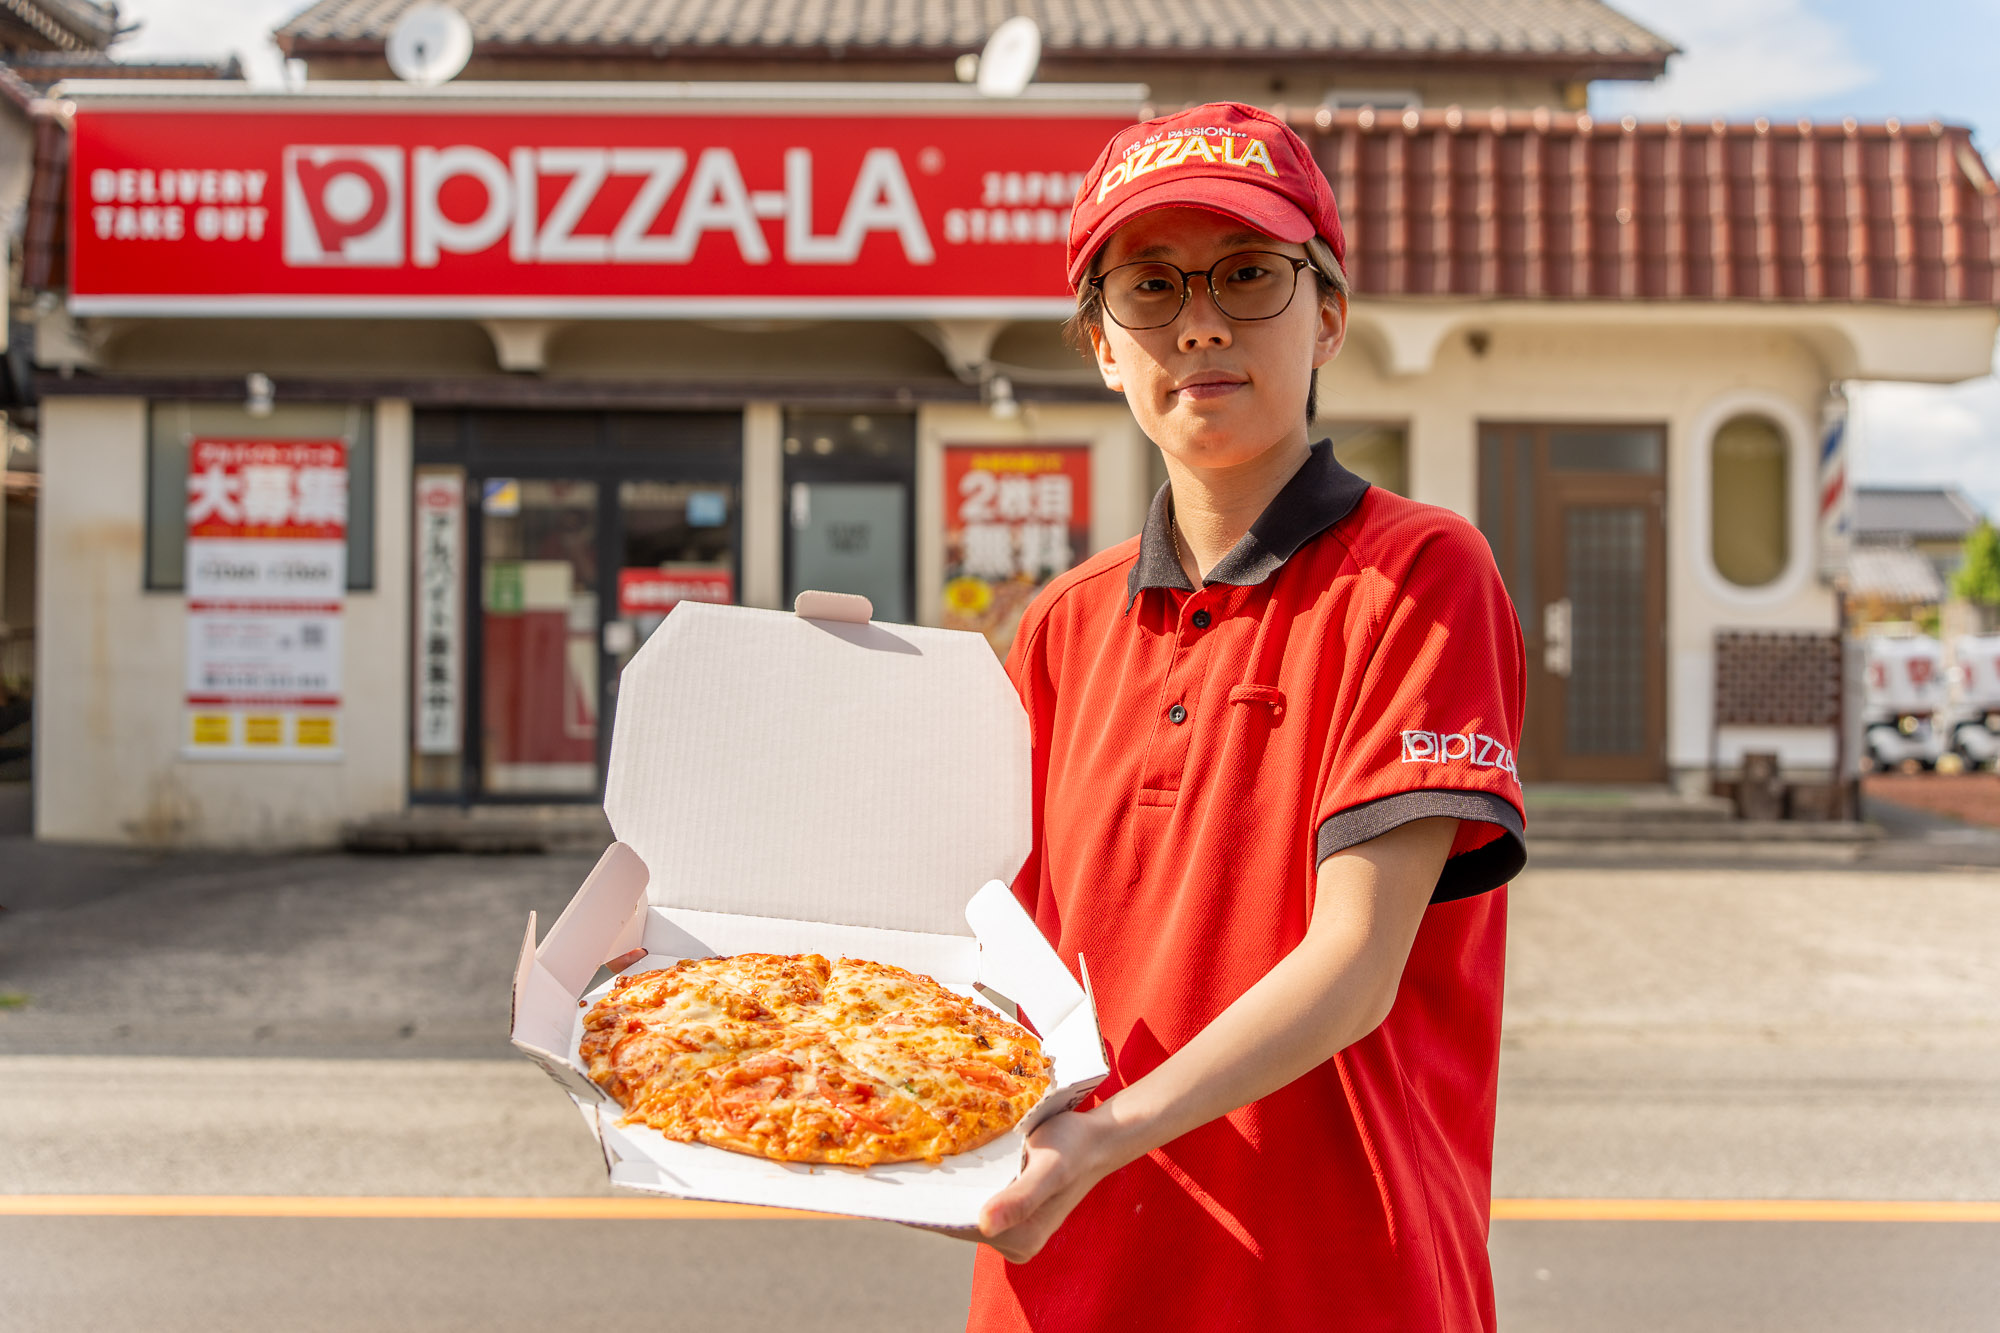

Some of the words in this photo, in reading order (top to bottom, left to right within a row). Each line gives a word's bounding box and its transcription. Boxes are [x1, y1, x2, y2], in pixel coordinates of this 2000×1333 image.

[1097, 135, 1280, 205] PIZZA-LA
[1122, 141, 1141, 160] IT'S
[1145, 132, 1163, 146] MY
[91, 169, 267, 204] DELIVERY
[411, 145, 936, 268] PIZZA-LA
[93, 206, 185, 240] TAKE
[195, 206, 267, 241] OUT
[187, 465, 347, 526] 大募集
[959, 471, 1073, 522] 2枚目
[1440, 732, 1522, 788] PIZZA
